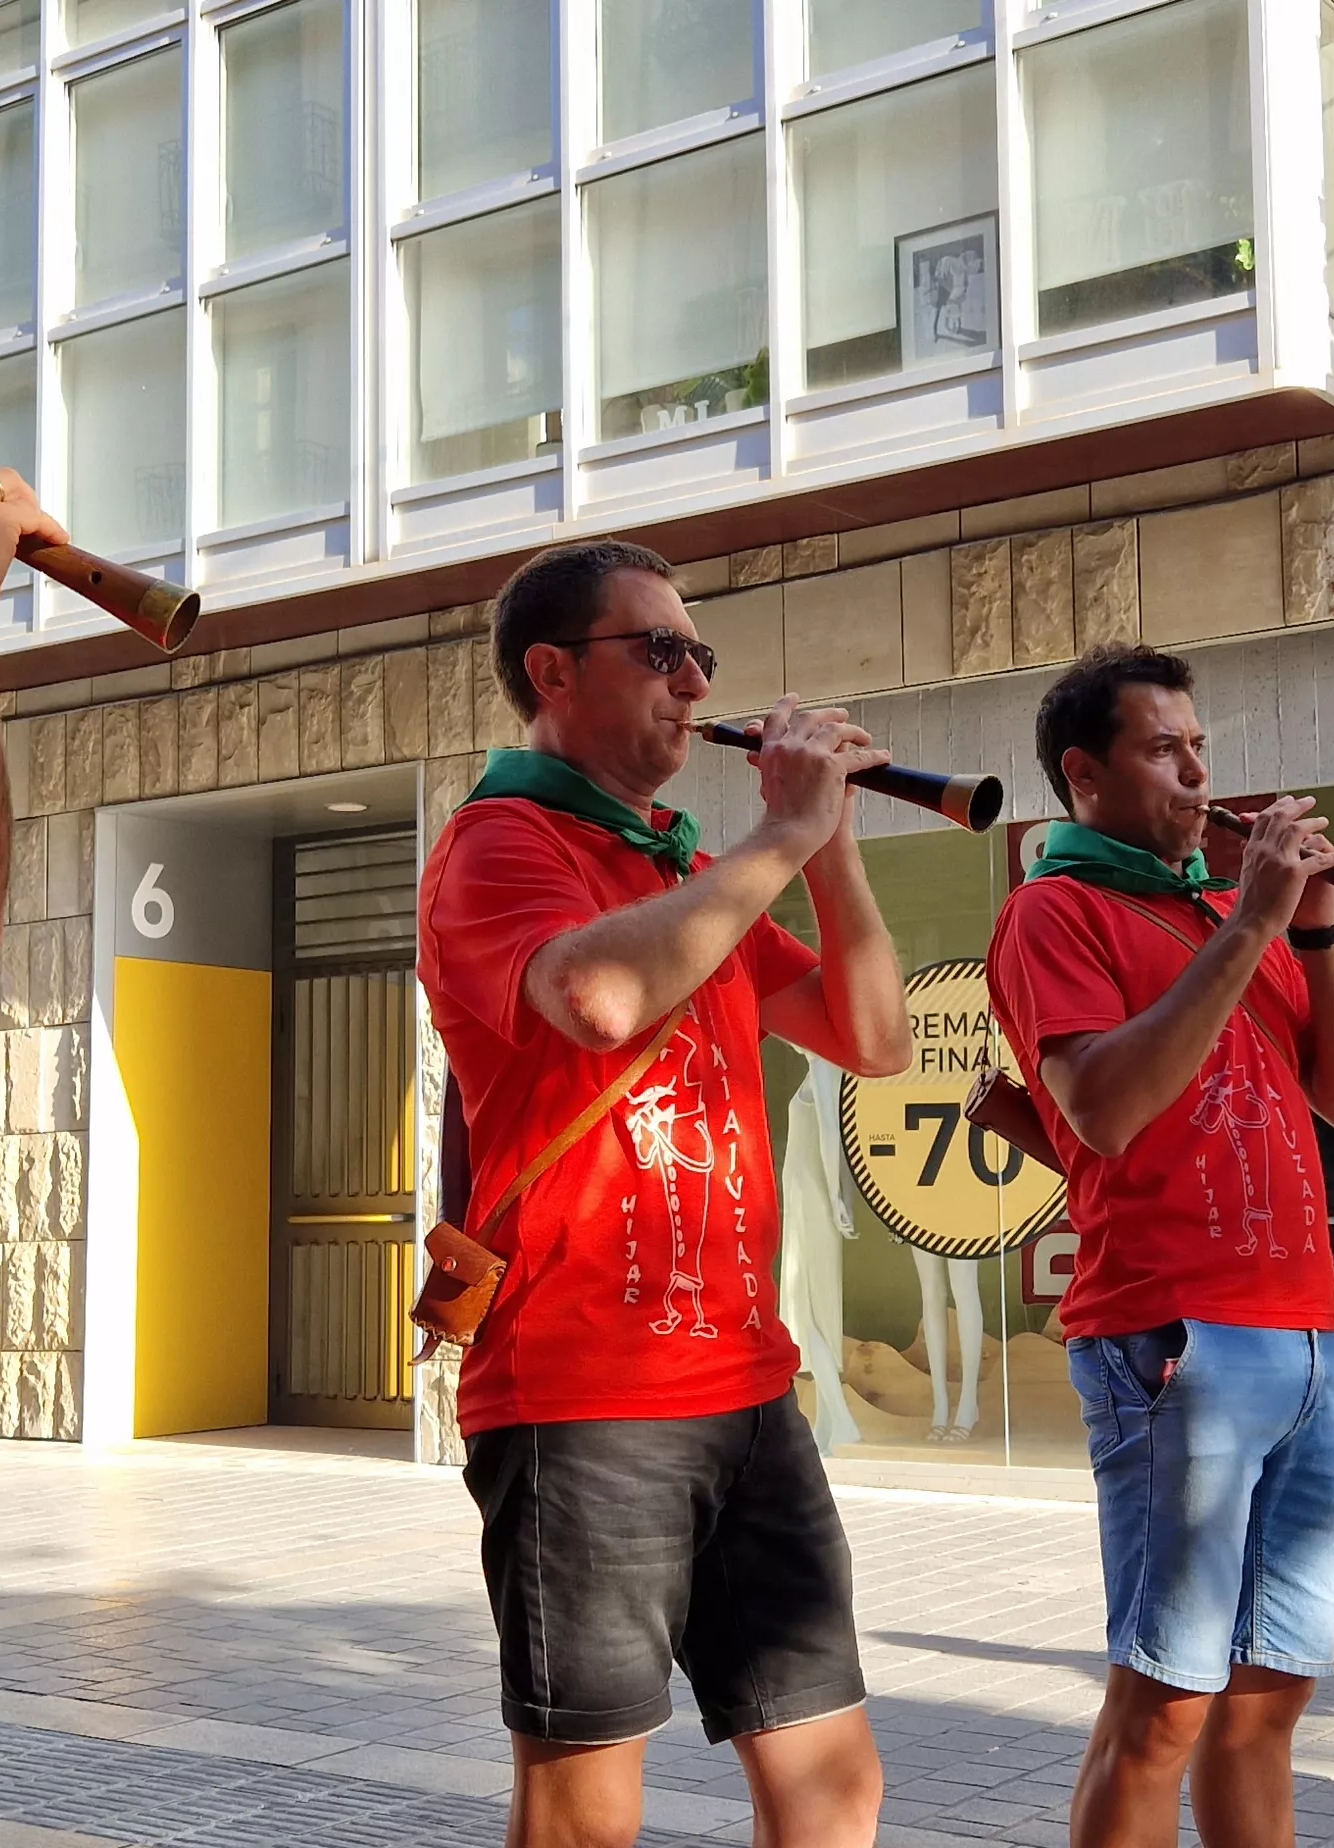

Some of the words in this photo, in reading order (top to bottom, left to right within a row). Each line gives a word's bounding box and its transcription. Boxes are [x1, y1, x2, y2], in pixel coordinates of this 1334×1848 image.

[131, 863, 175, 938] 6
[910, 1011, 1004, 1039] REMA
[921, 1046, 1010, 1073] FINAL
[868, 1133, 896, 1142] HASTA
